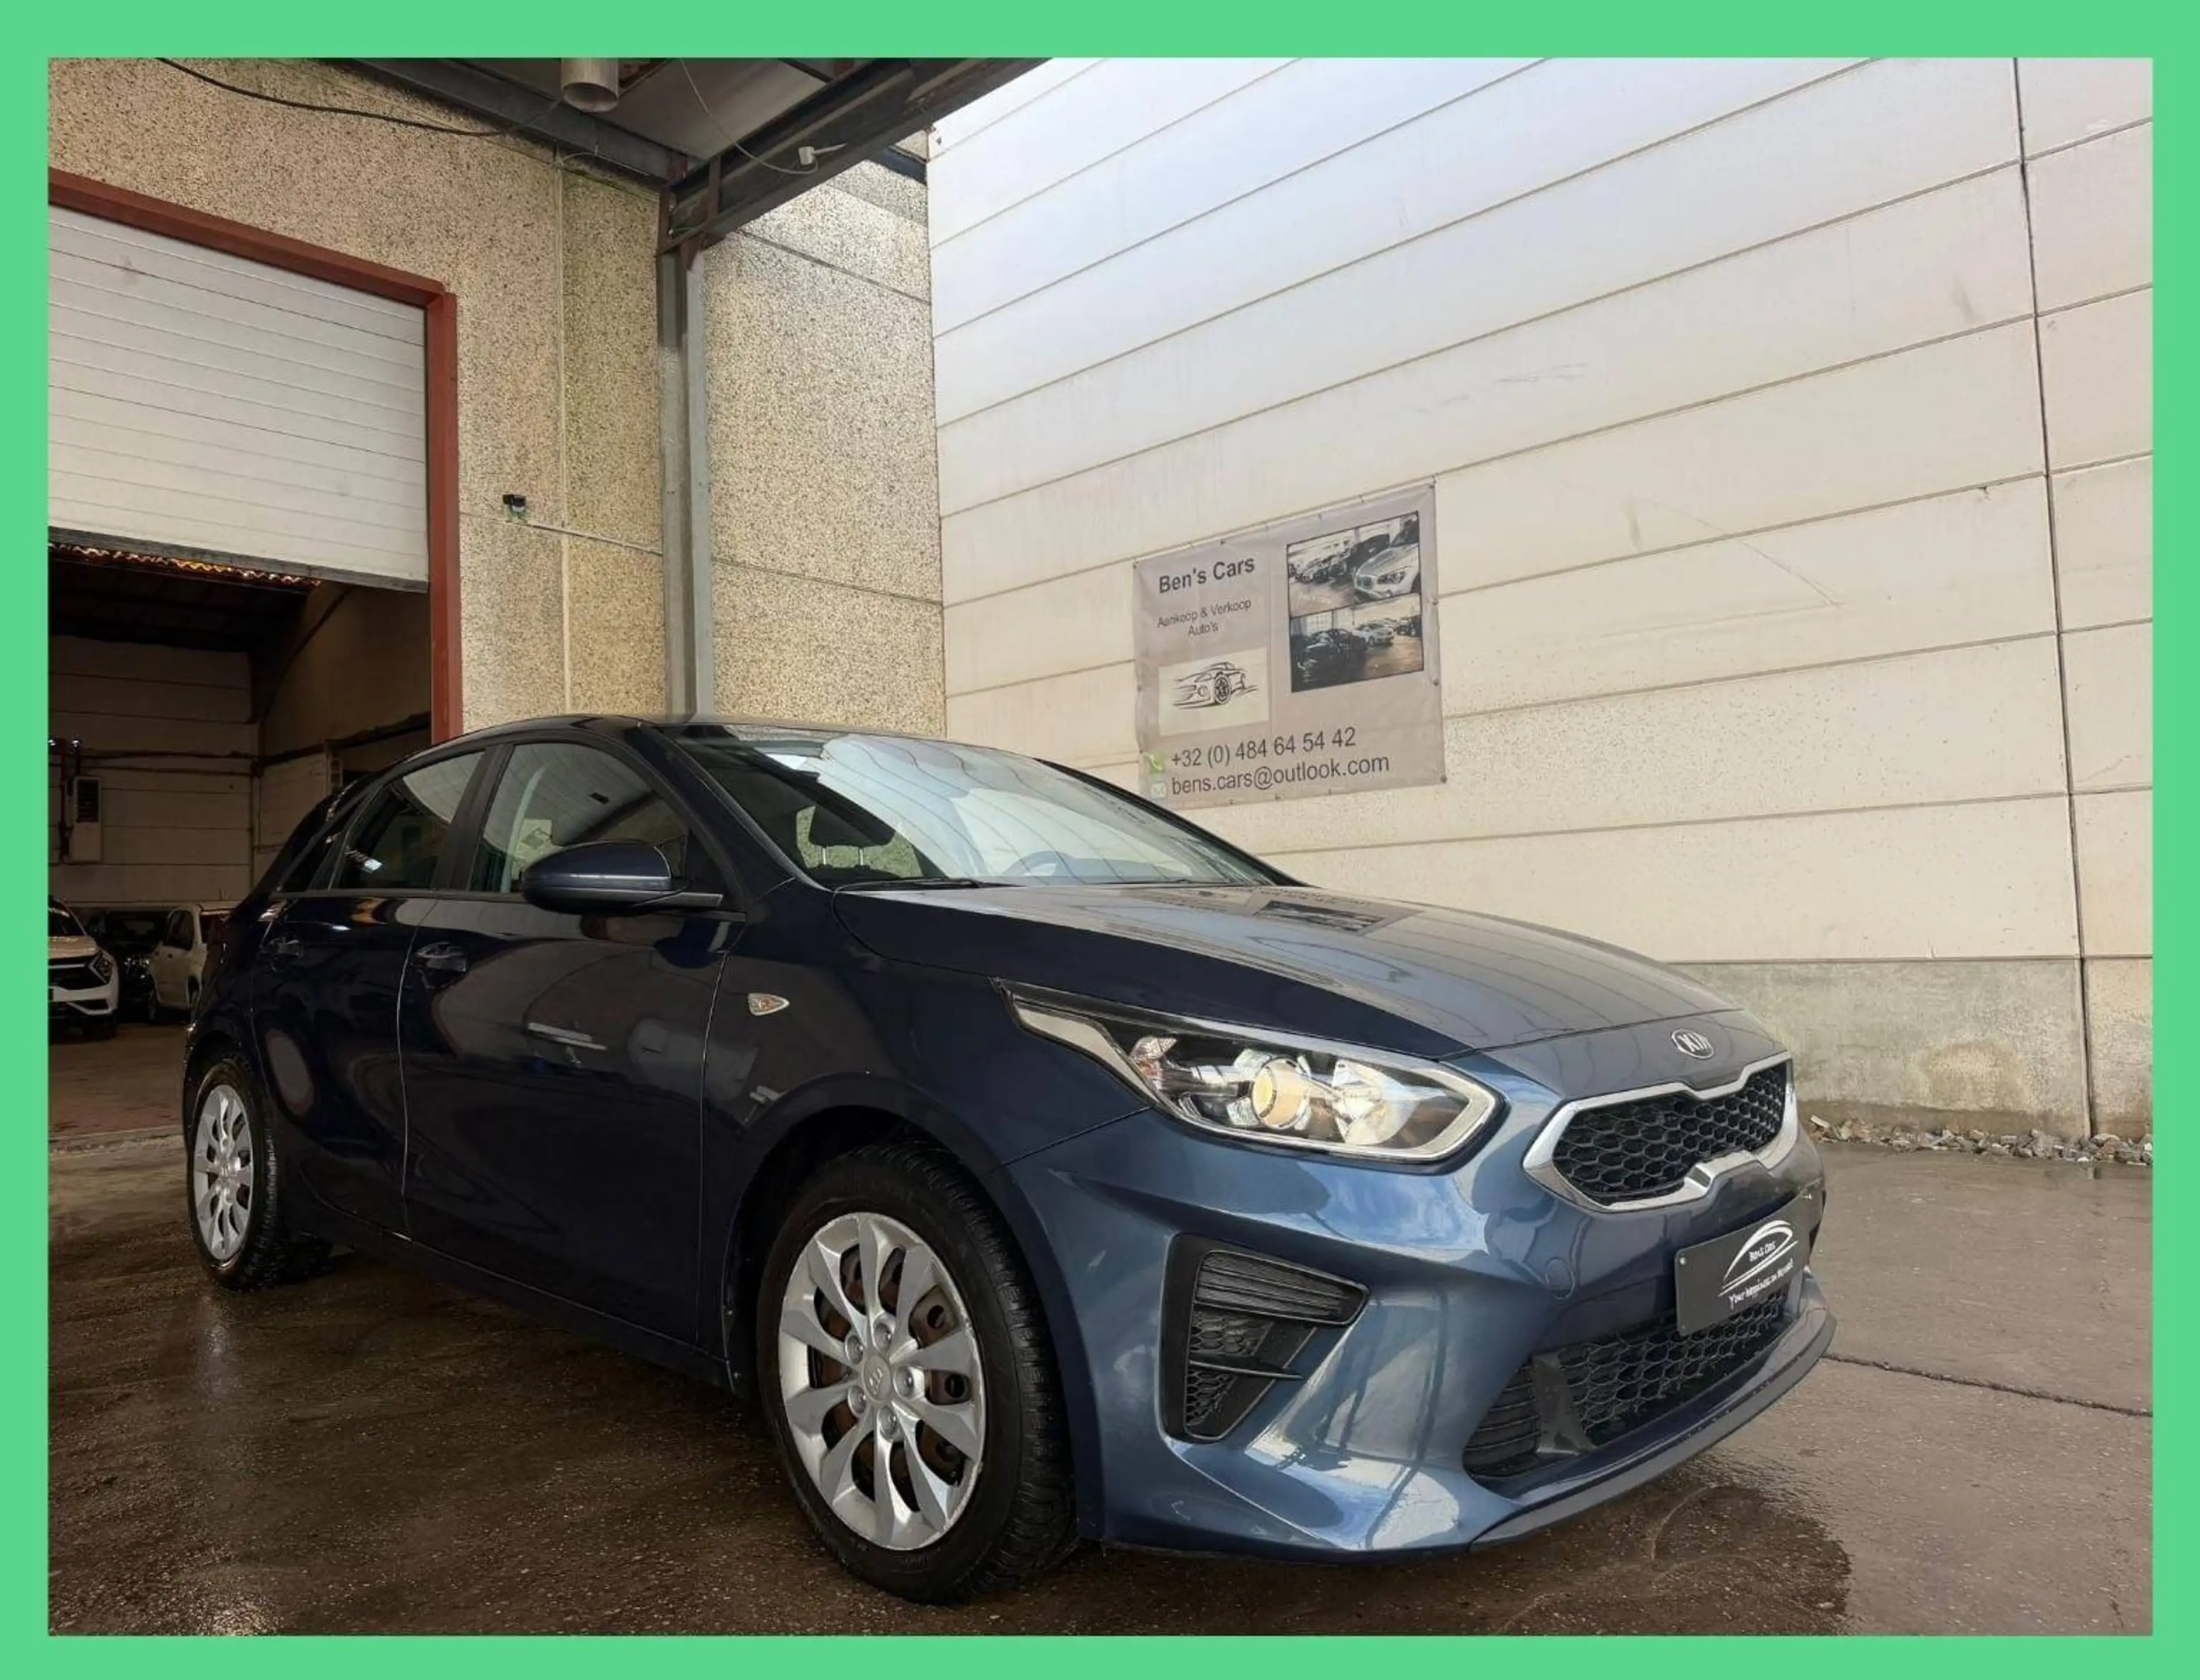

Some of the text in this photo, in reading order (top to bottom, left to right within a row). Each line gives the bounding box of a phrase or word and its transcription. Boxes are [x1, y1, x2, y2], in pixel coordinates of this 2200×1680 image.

[1159, 558, 1255, 594] Ben's Cars
[1201, 607, 1208, 618] &
[1211, 600, 1251, 617] Verkoop
[1188, 621, 1219, 637] Auto's
[1171, 726, 1356, 768] +32 (0) 484 64 54 42
[1171, 756, 1390, 795] bens.cars@outlook.com
